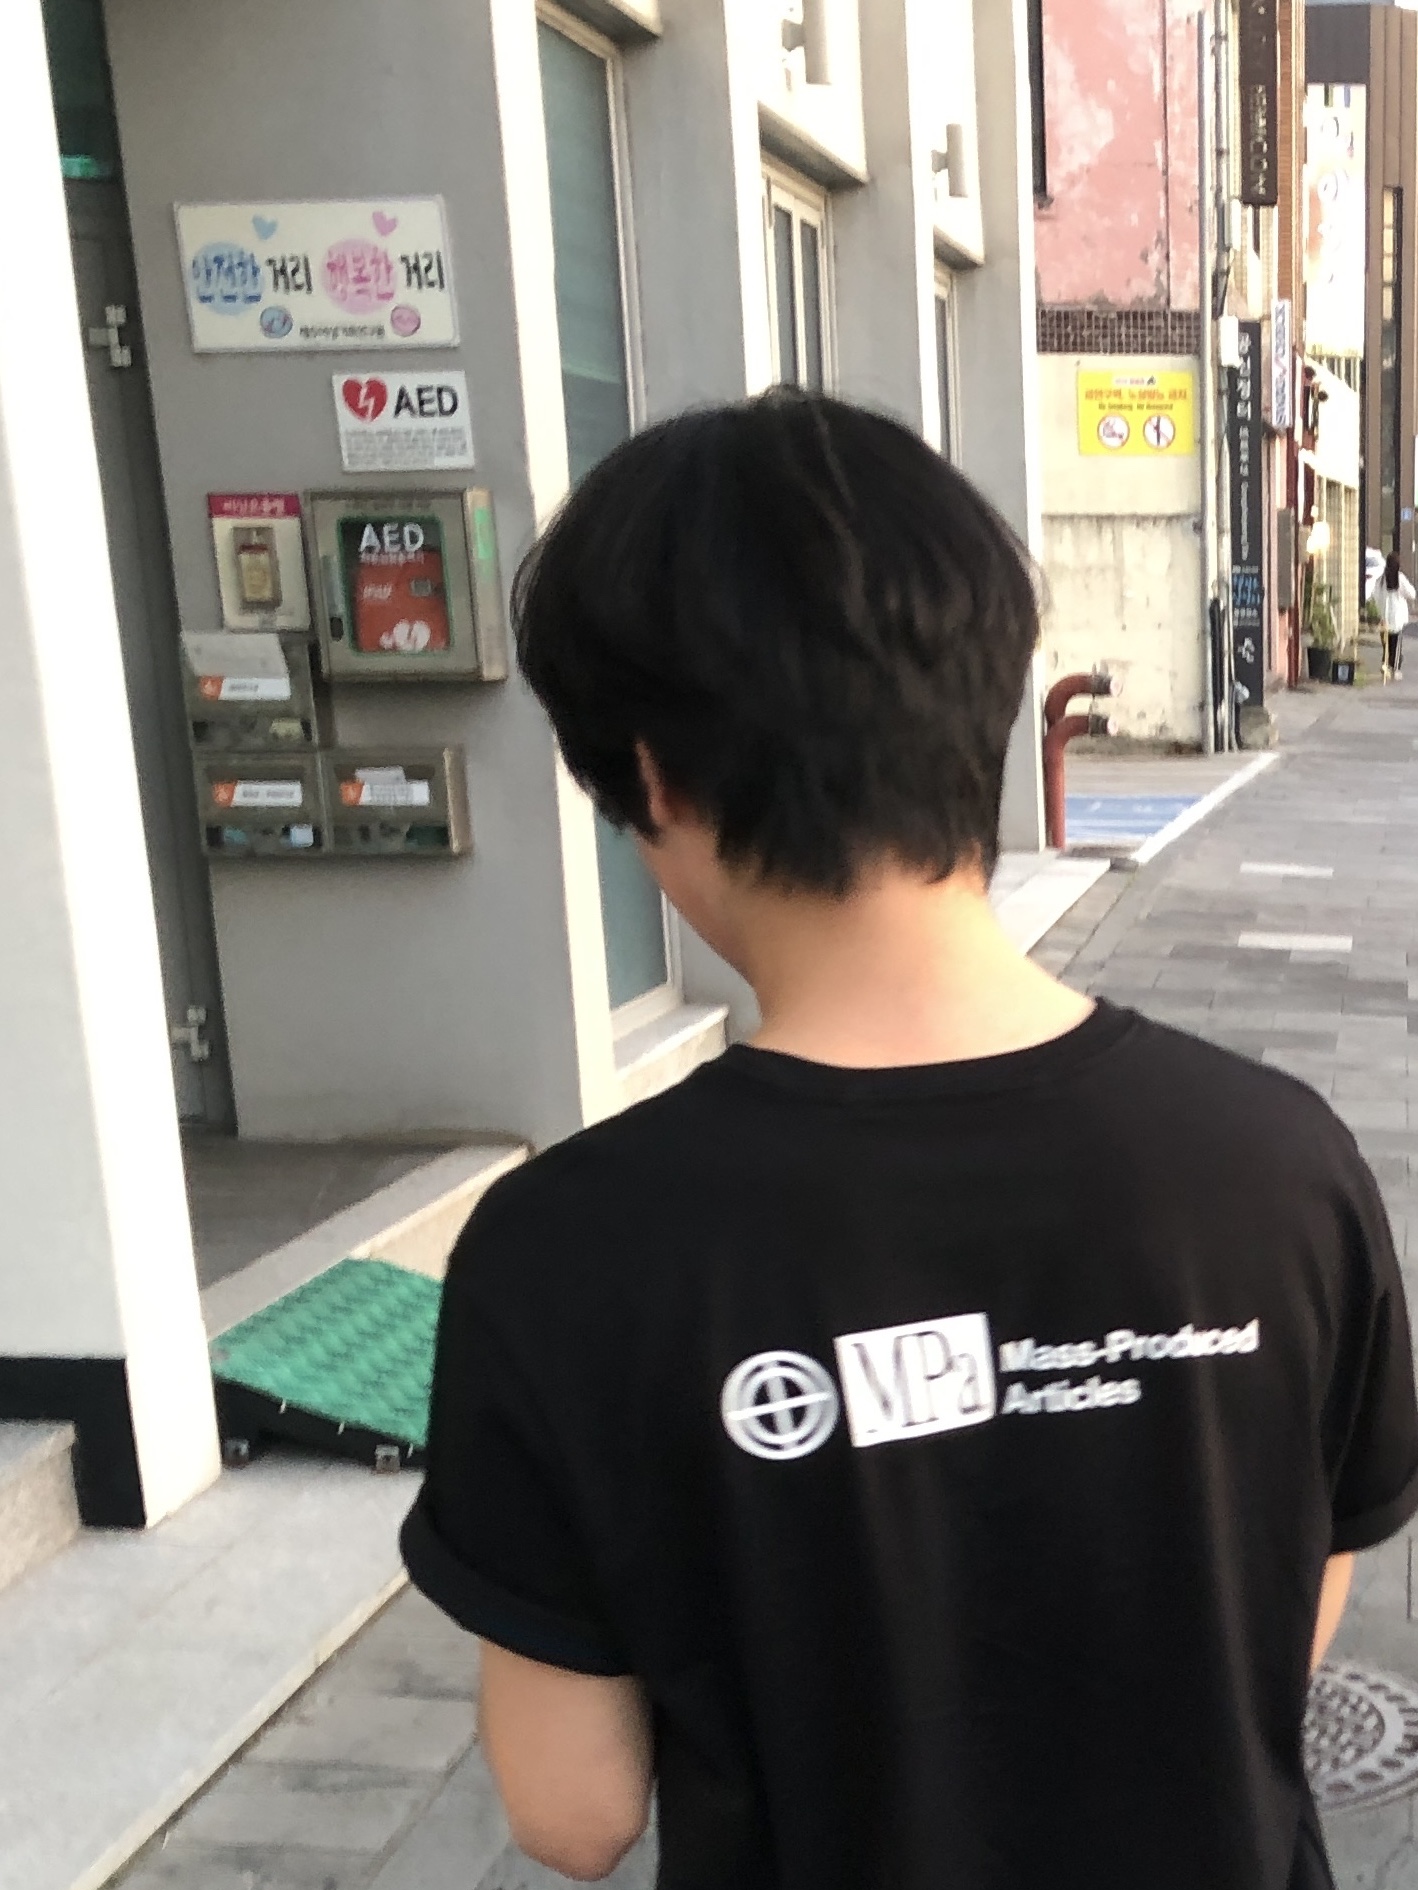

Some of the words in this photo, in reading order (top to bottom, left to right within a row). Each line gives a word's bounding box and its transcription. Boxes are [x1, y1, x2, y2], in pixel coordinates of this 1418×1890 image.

[191, 249, 261, 304] 안전한
[266, 252, 314, 294] 거리
[325, 246, 395, 303] 행복한
[399, 249, 446, 291] 거리
[393, 383, 460, 419] AED
[358, 521, 425, 552] AED
[851, 1328, 983, 1436] MPa
[999, 1316, 1261, 1374] Mass-Produced
[999, 1375, 1142, 1416] Articles
